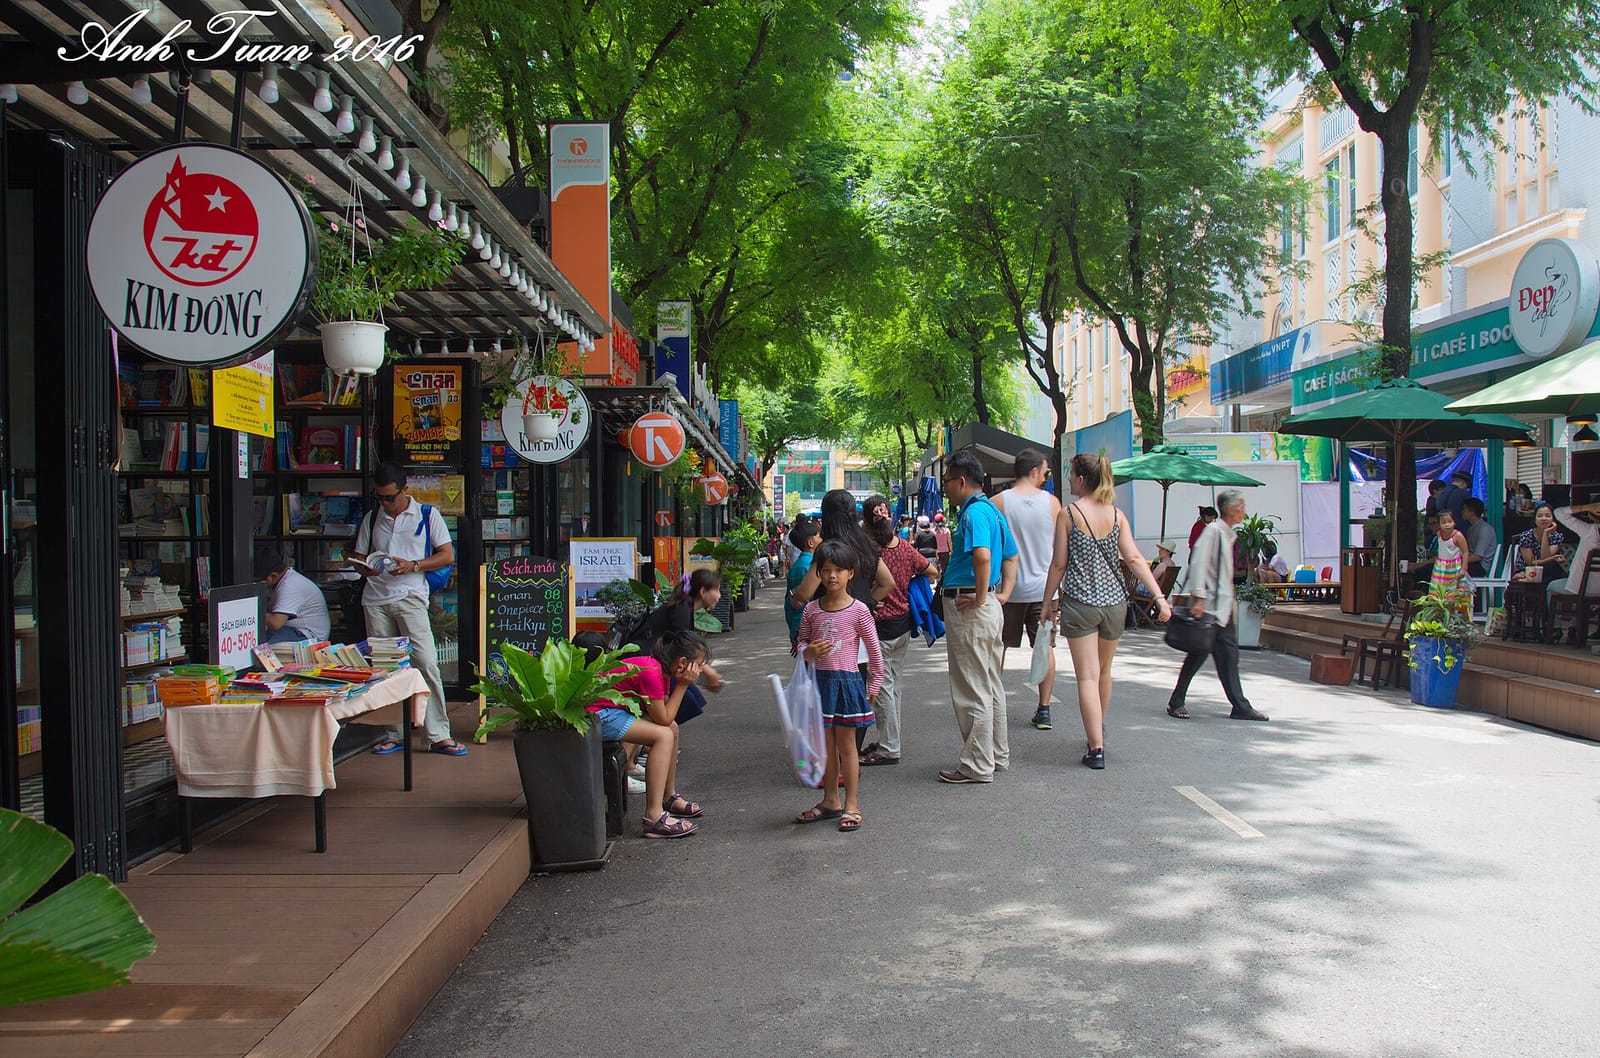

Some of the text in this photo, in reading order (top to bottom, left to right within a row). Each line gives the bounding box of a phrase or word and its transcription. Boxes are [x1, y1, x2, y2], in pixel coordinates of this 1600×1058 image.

[122, 278, 263, 338] KIM ĐỒNG
[1271, 338, 1291, 353] VNPT
[1304, 372, 1327, 393] CAFÉ
[1430, 332, 1467, 360] CAFÉ
[721, 402, 730, 446] First News
[580, 555, 626, 566] ISRAEL
[546, 601, 564, 615] 58
[551, 617, 563, 634] 8
